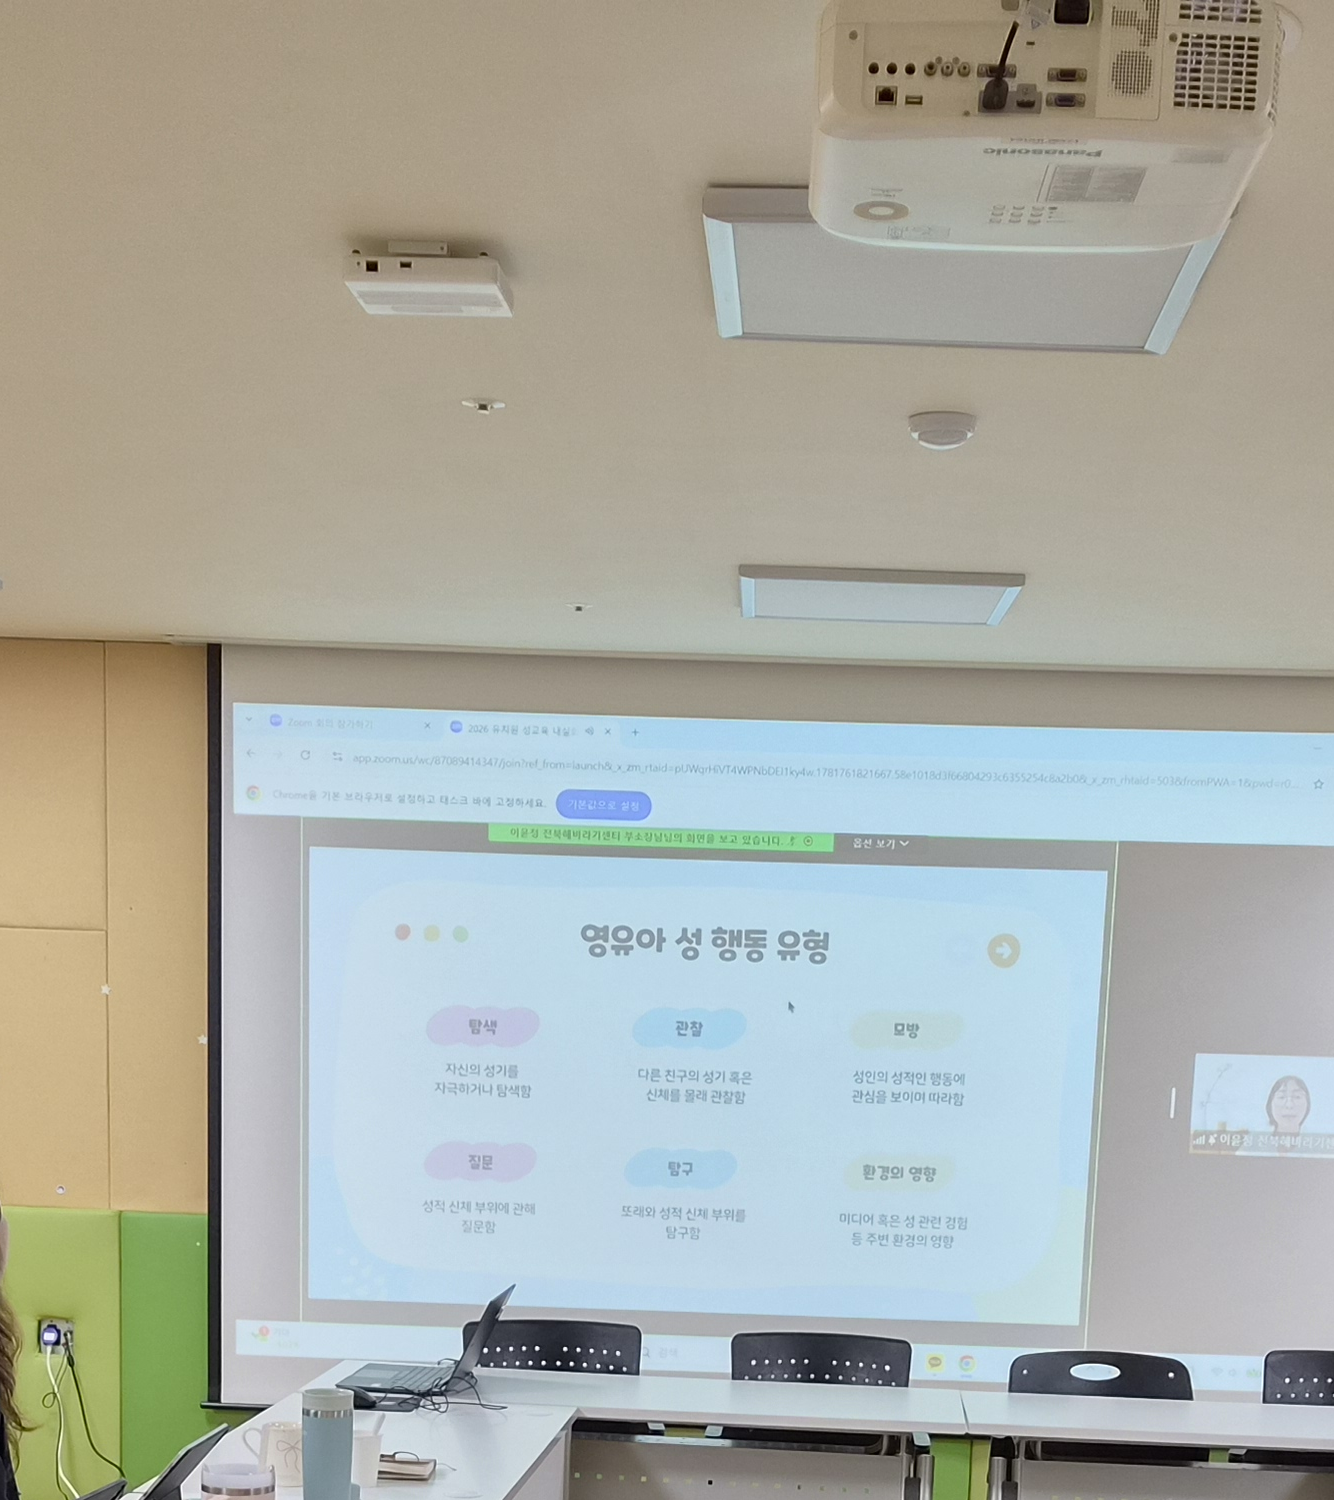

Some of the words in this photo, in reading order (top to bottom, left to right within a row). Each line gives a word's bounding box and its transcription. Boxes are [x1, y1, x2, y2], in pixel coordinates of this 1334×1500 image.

[983, 147, 1103, 158] Panasonic
[288, 718, 313, 727] Zoom
[468, 723, 490, 734] 2026
[493, 724, 519, 735] 유치원
[523, 725, 549, 736] 성교육
[272, 789, 317, 802] Chrome을
[322, 790, 340, 803] 기본
[345, 791, 393, 804] 브라우저로
[397, 793, 435, 805] 설정하고
[440, 794, 468, 806] 태스크
[568, 799, 616, 810] 기본값으로
[621, 800, 640, 812] 설정
[542, 828, 620, 841] 전북해바라기센터
[686, 833, 715, 845] 화면을
[719, 834, 738, 844] 보고
[853, 837, 872, 849] 옵션
[875, 838, 896, 850] 보기
[580, 923, 667, 958] 영유아
[675, 927, 702, 961] 성
[711, 926, 768, 963] 행동
[777, 929, 830, 965] 유형
[468, 1018, 498, 1036] 탐색
[675, 1020, 703, 1037] 관찰
[893, 1022, 920, 1039] 모방
[445, 1063, 481, 1077] 자신의
[484, 1064, 519, 1079] 성기를
[638, 1068, 662, 1083] 다른
[664, 1069, 700, 1083] 친구의
[703, 1070, 726, 1084] 성기
[729, 1071, 753, 1086] 혹은
[853, 1070, 888, 1084] 성인의
[891, 1071, 927, 1086] 성적인
[930, 1072, 966, 1087] 행동에
[434, 1082, 493, 1096] 자극하거나
[496, 1084, 532, 1099] 탐색함
[646, 1088, 681, 1103] 신체를
[684, 1089, 708, 1103] 몰래
[711, 1090, 746, 1105] 관찰함
[852, 1090, 887, 1104] 관심을
[890, 1091, 926, 1104] 보이며
[928, 1092, 965, 1107] 따라함
[468, 1154, 493, 1171] 질문
[668, 1161, 694, 1177] 탐구
[862, 1164, 904, 1181] 환경의
[908, 1166, 937, 1182] 영향
[422, 1199, 445, 1213] 성적
[449, 1200, 472, 1214] 신체
[475, 1201, 510, 1215] 부위에
[513, 1202, 536, 1216] 관해
[621, 1205, 656, 1218] 또래와
[659, 1207, 682, 1221] 성적
[685, 1207, 709, 1221] 신체
[711, 1208, 746, 1223] 부위를
[461, 1220, 497, 1234] 질문함
[839, 1213, 874, 1226] 미디어
[877, 1213, 901, 1228] 혹은
[904, 1214, 915, 1229] 성
[918, 1215, 942, 1229] 관련
[945, 1216, 968, 1231] 경험
[665, 1226, 701, 1240] 탐구함
[851, 1232, 863, 1246] 등
[866, 1232, 889, 1247] 주변
[892, 1233, 927, 1248] 환경의
[930, 1234, 954, 1249] 영향
